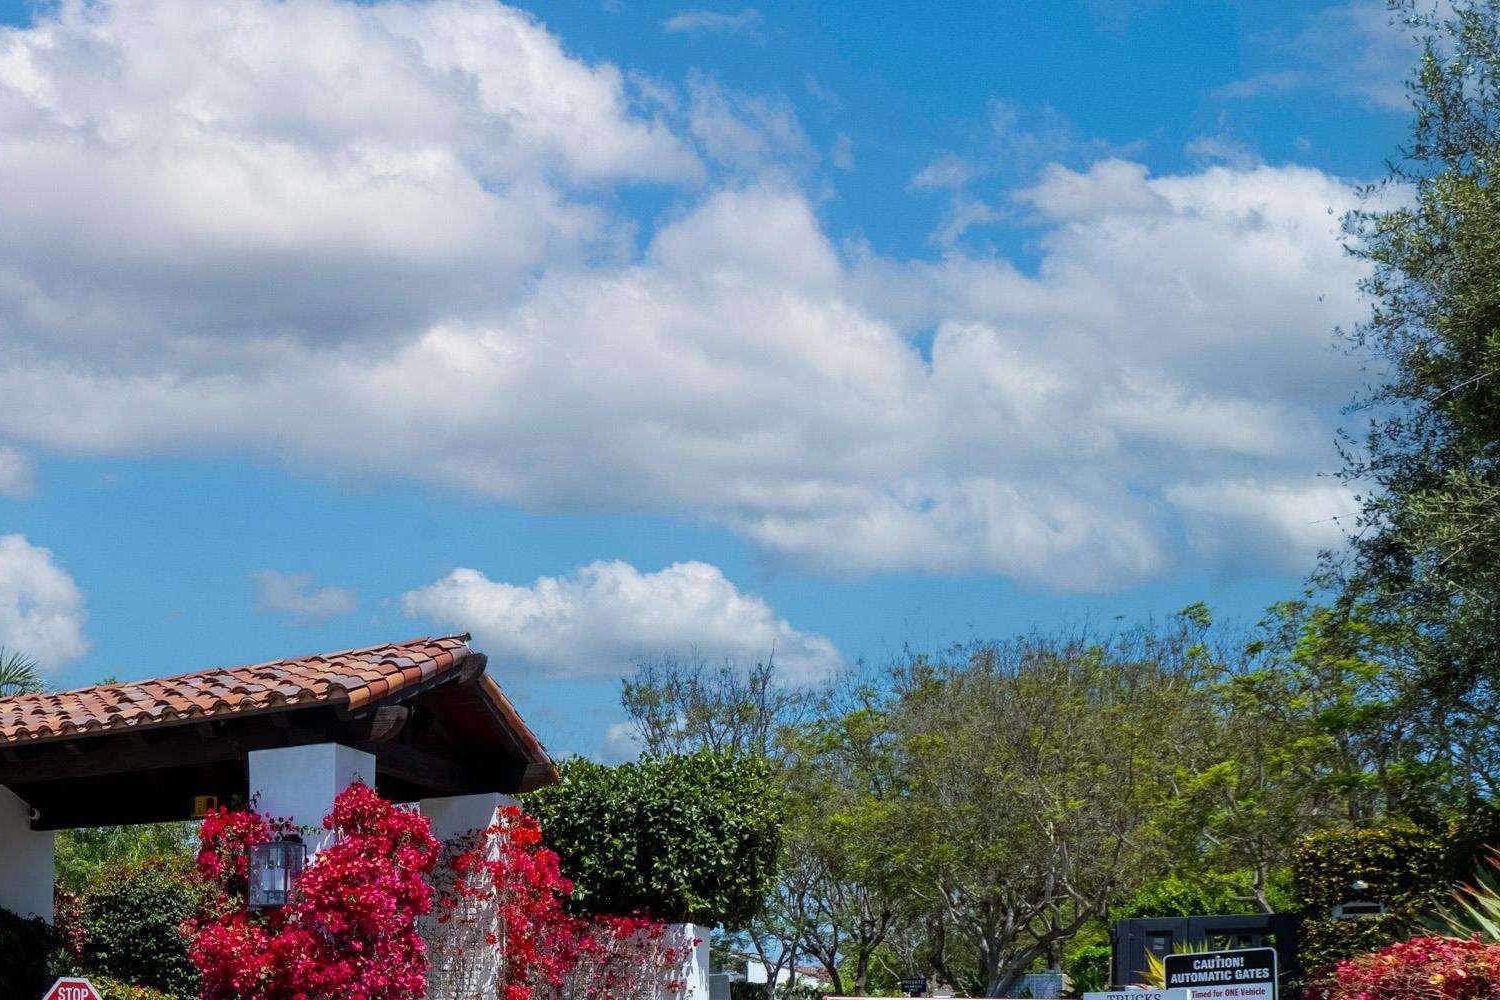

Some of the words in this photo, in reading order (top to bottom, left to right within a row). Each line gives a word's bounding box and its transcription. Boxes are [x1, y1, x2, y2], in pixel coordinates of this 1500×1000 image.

[1193, 957, 1244, 970] CAUTION!
[1170, 971, 1232, 984] AUTOMATIC
[1234, 968, 1270, 980] GATES
[1191, 990, 1212, 998] Timed
[1213, 990, 1223, 998] for
[1241, 988, 1266, 996] Vehicle
